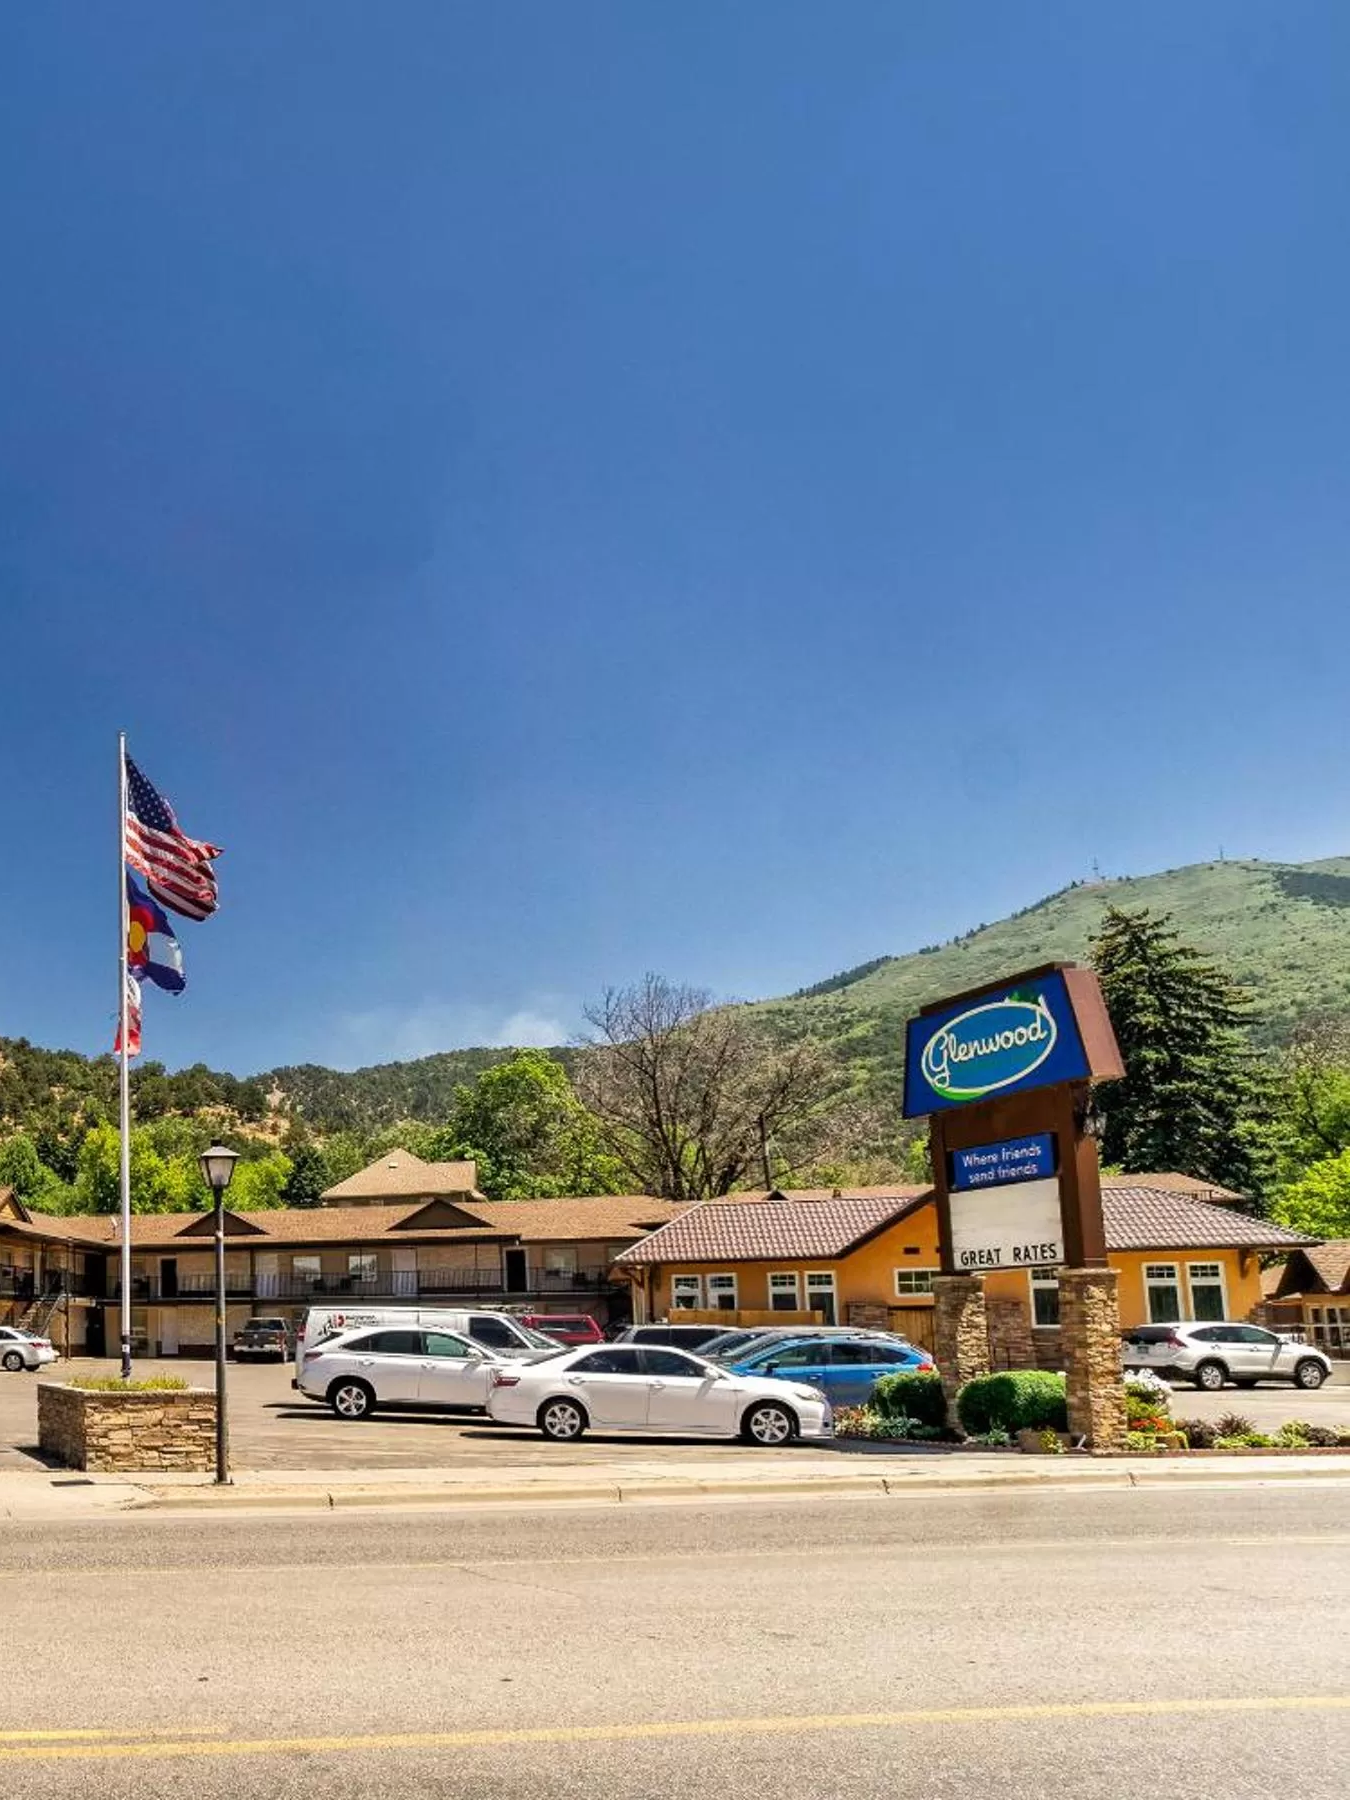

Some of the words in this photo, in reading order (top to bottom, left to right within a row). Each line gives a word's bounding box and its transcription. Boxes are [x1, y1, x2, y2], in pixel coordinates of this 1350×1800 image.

[929, 1008, 1048, 1088] Glenwood
[962, 1152, 998, 1168] Where
[1001, 1143, 1041, 1161] friends
[969, 1167, 995, 1183] send
[997, 1160, 1038, 1178] friends
[960, 1248, 1001, 1266] GREAT
[1012, 1243, 1057, 1262] RATES
